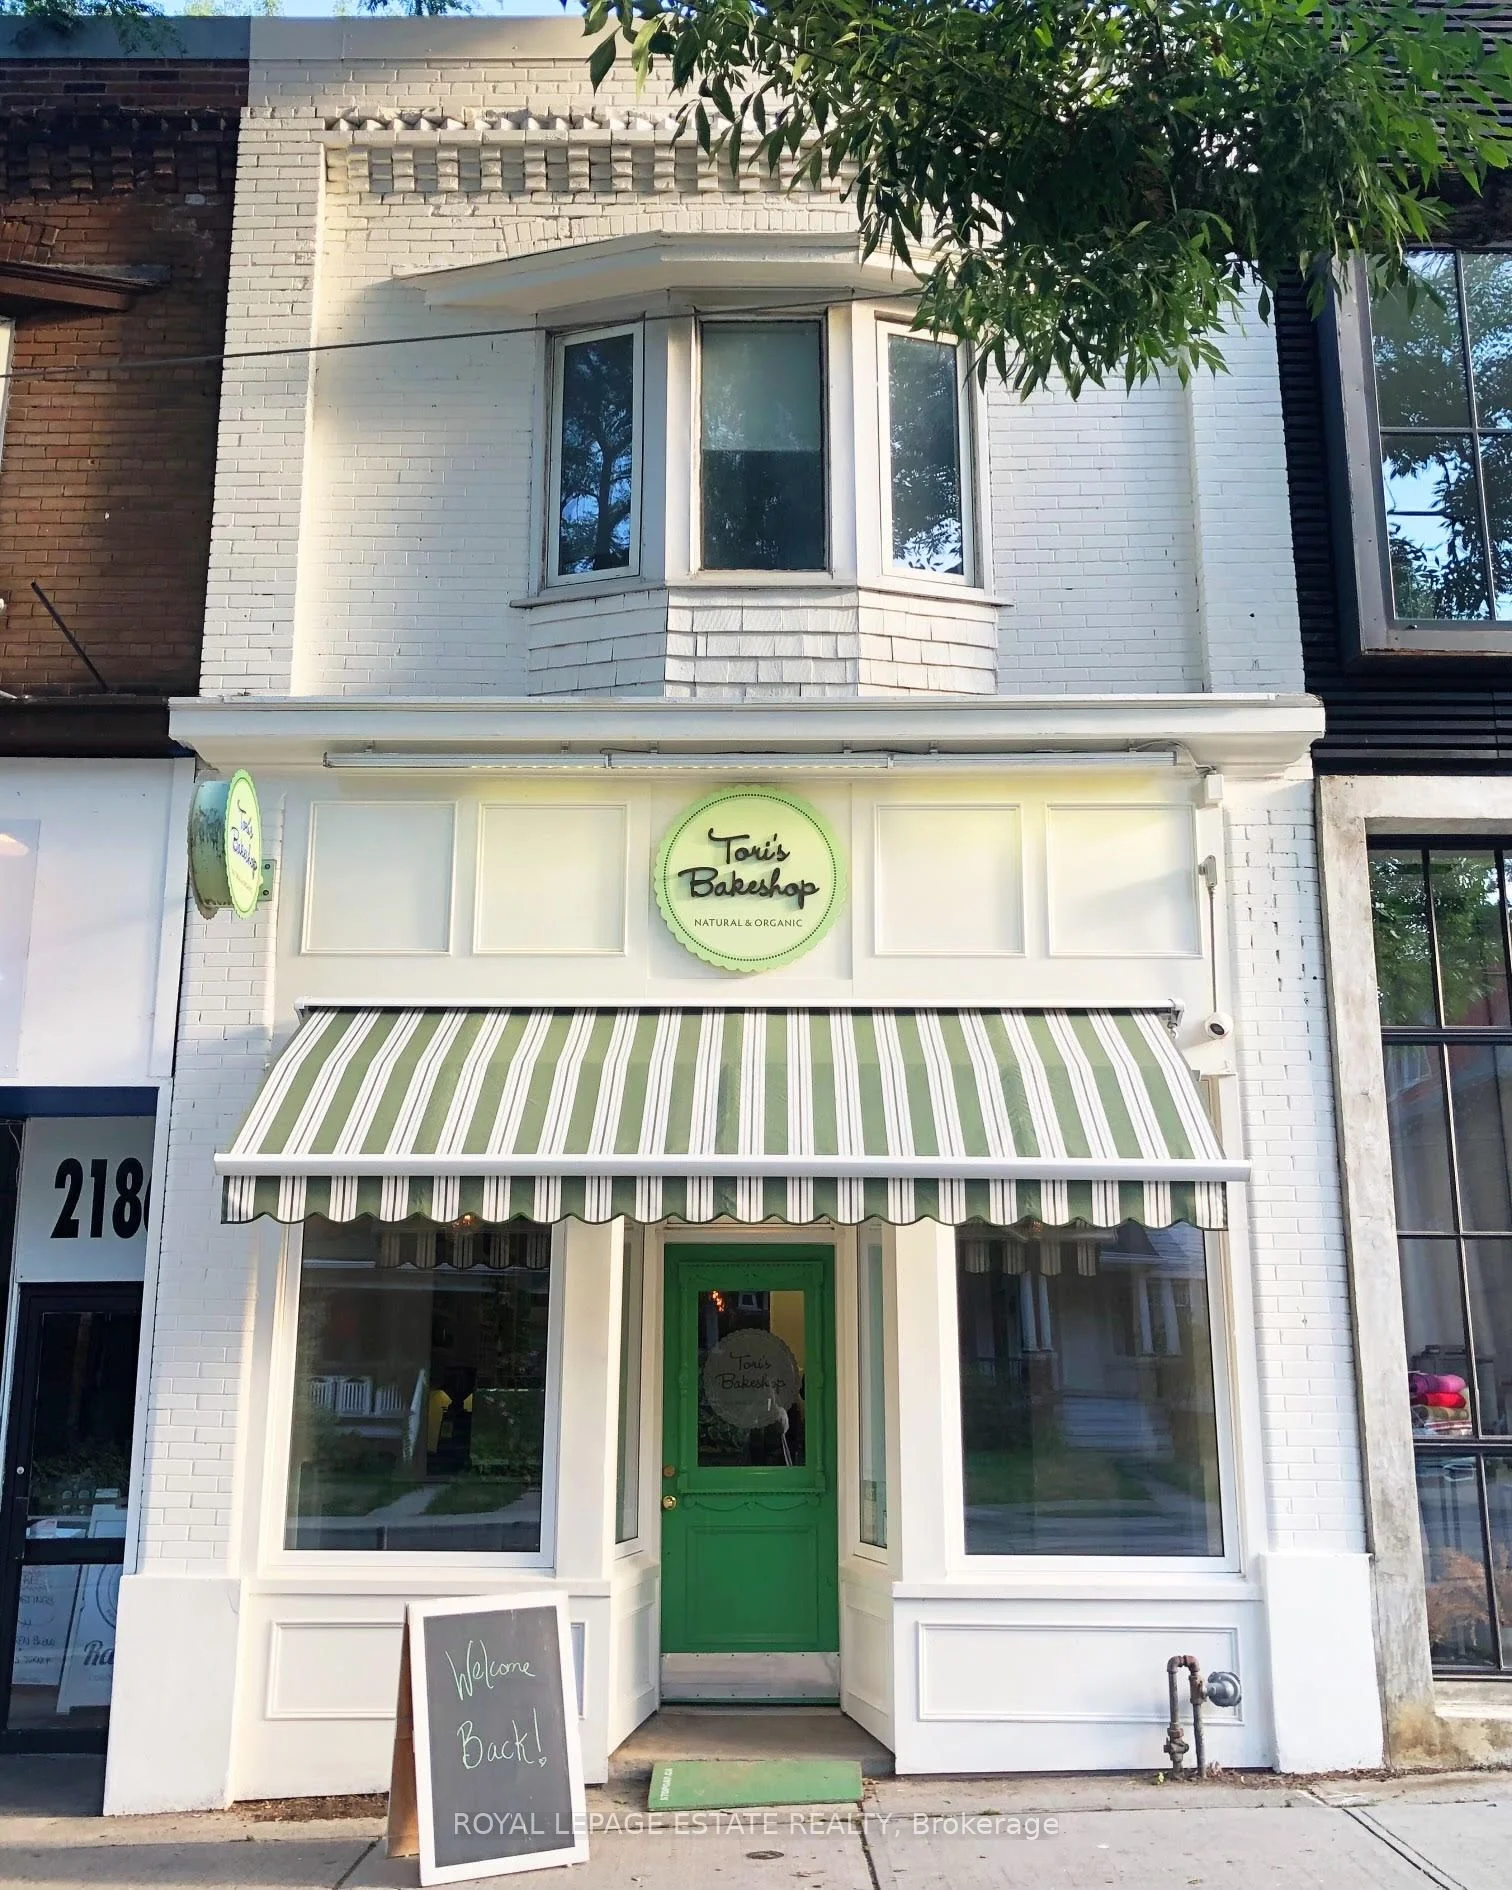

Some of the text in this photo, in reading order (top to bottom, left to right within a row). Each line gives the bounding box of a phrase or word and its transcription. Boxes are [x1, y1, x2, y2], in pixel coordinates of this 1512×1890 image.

[707, 827, 791, 865] Tori's
[677, 866, 821, 910] Bakeshop
[694, 918, 804, 928] NATURAL & ORGANIC
[50, 1157, 152, 1239] 218
[730, 1351, 772, 1371] Tori's
[715, 1372, 787, 1395] Bakeshop
[444, 1639, 536, 1701] Welcome
[456, 1706, 548, 1770] Back!
